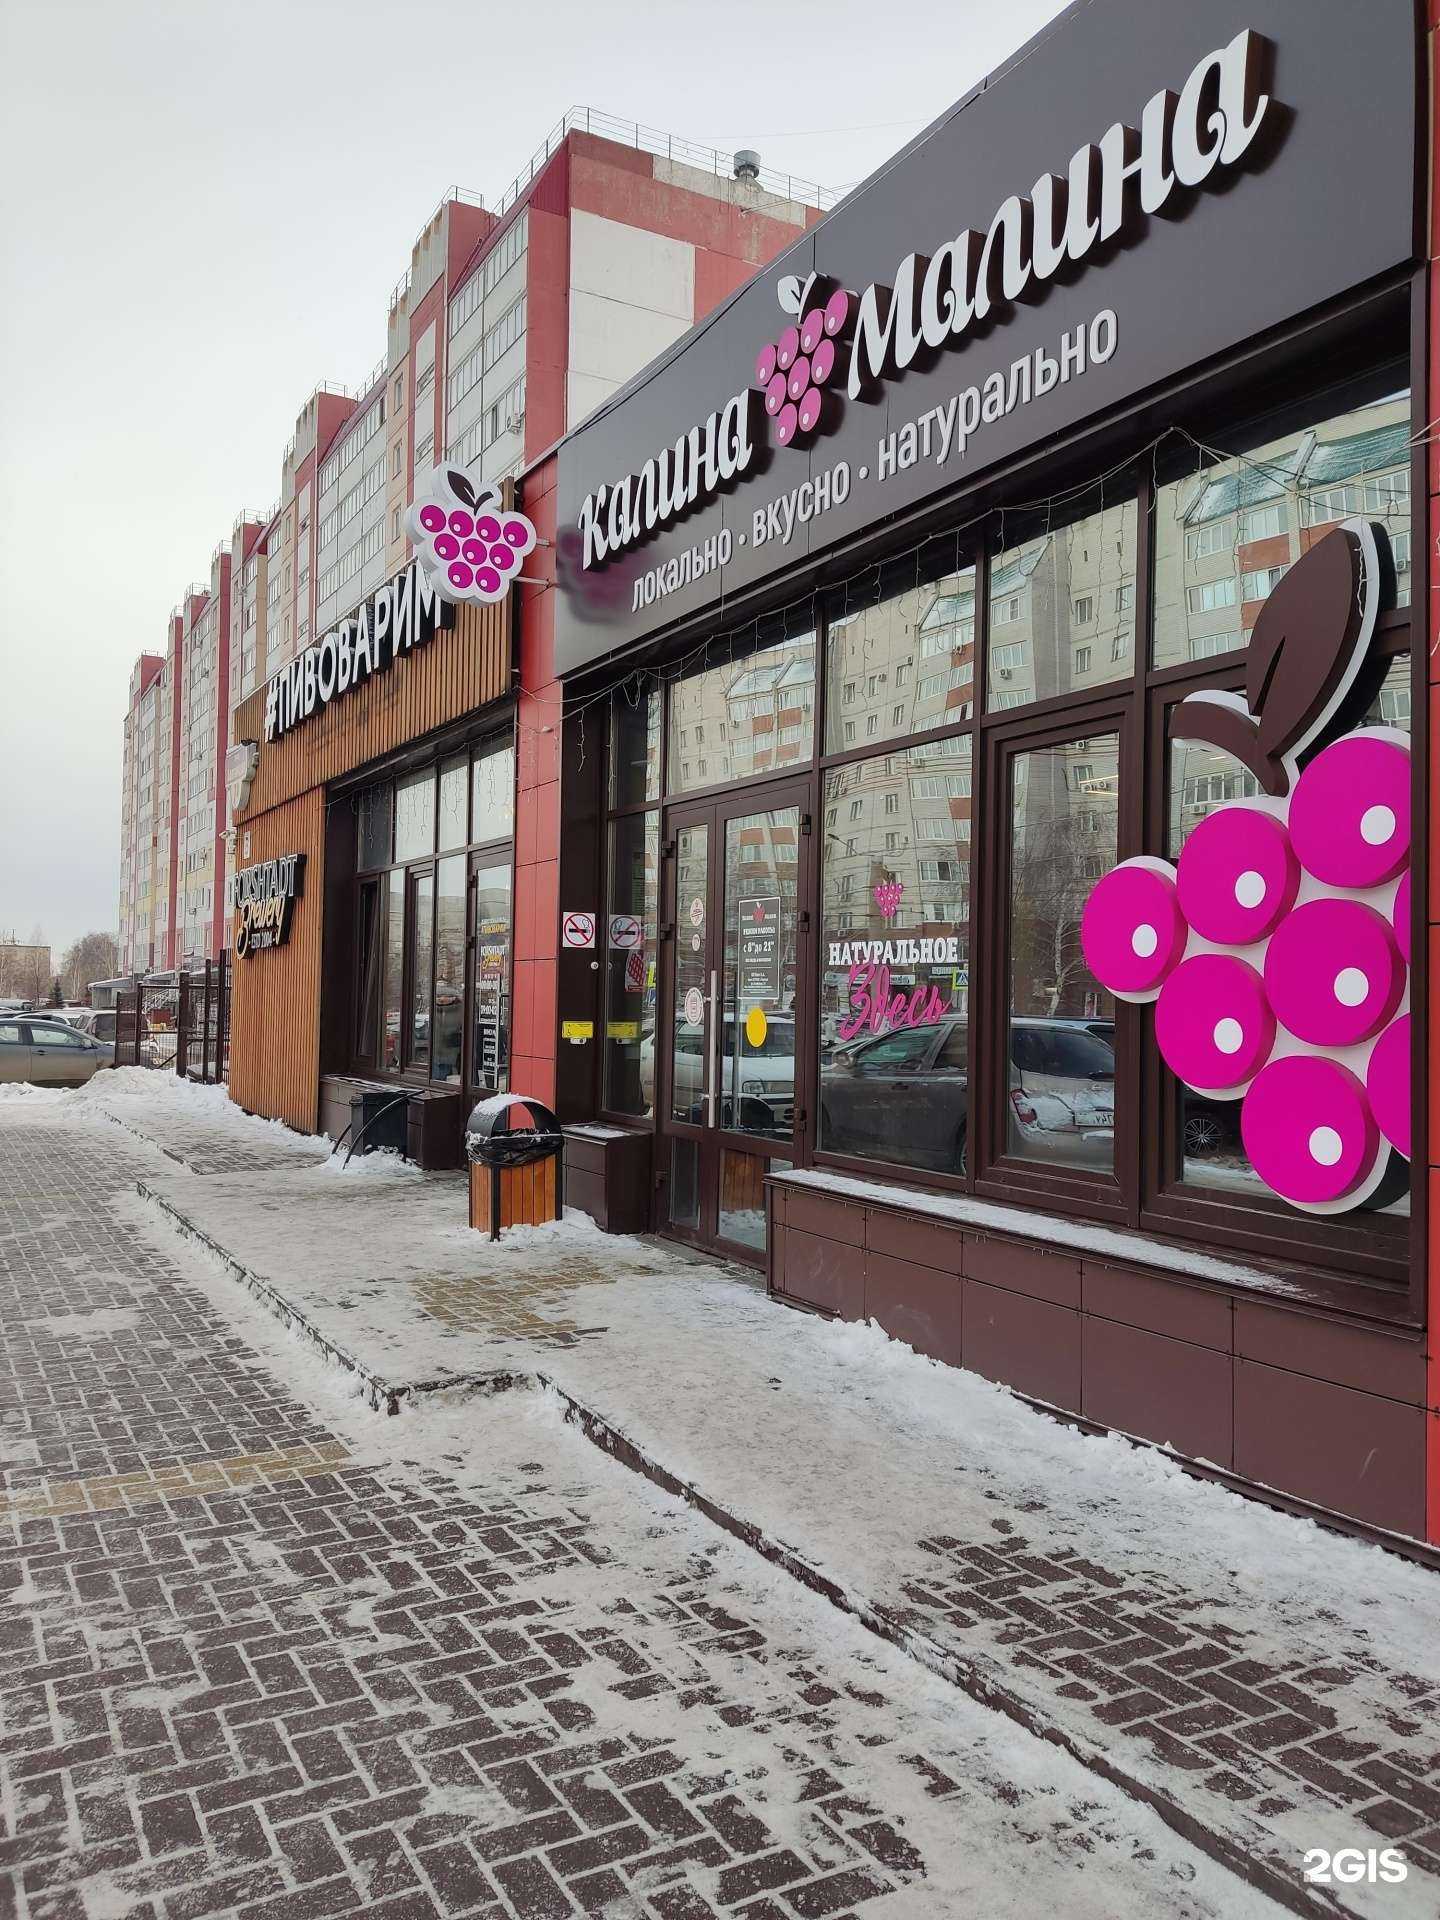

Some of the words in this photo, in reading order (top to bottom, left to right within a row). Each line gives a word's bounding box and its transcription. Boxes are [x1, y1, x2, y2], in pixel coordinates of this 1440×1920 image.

[632, 528, 732, 613] локально
[753, 461, 850, 549] вкусно
[878, 308, 1119, 481] натурально
[264, 562, 442, 743] #ПИВОВАРИМ
[828, 937, 959, 966] НАТУРАЛЬНОЕ
[838, 963, 950, 1041] Здесь
